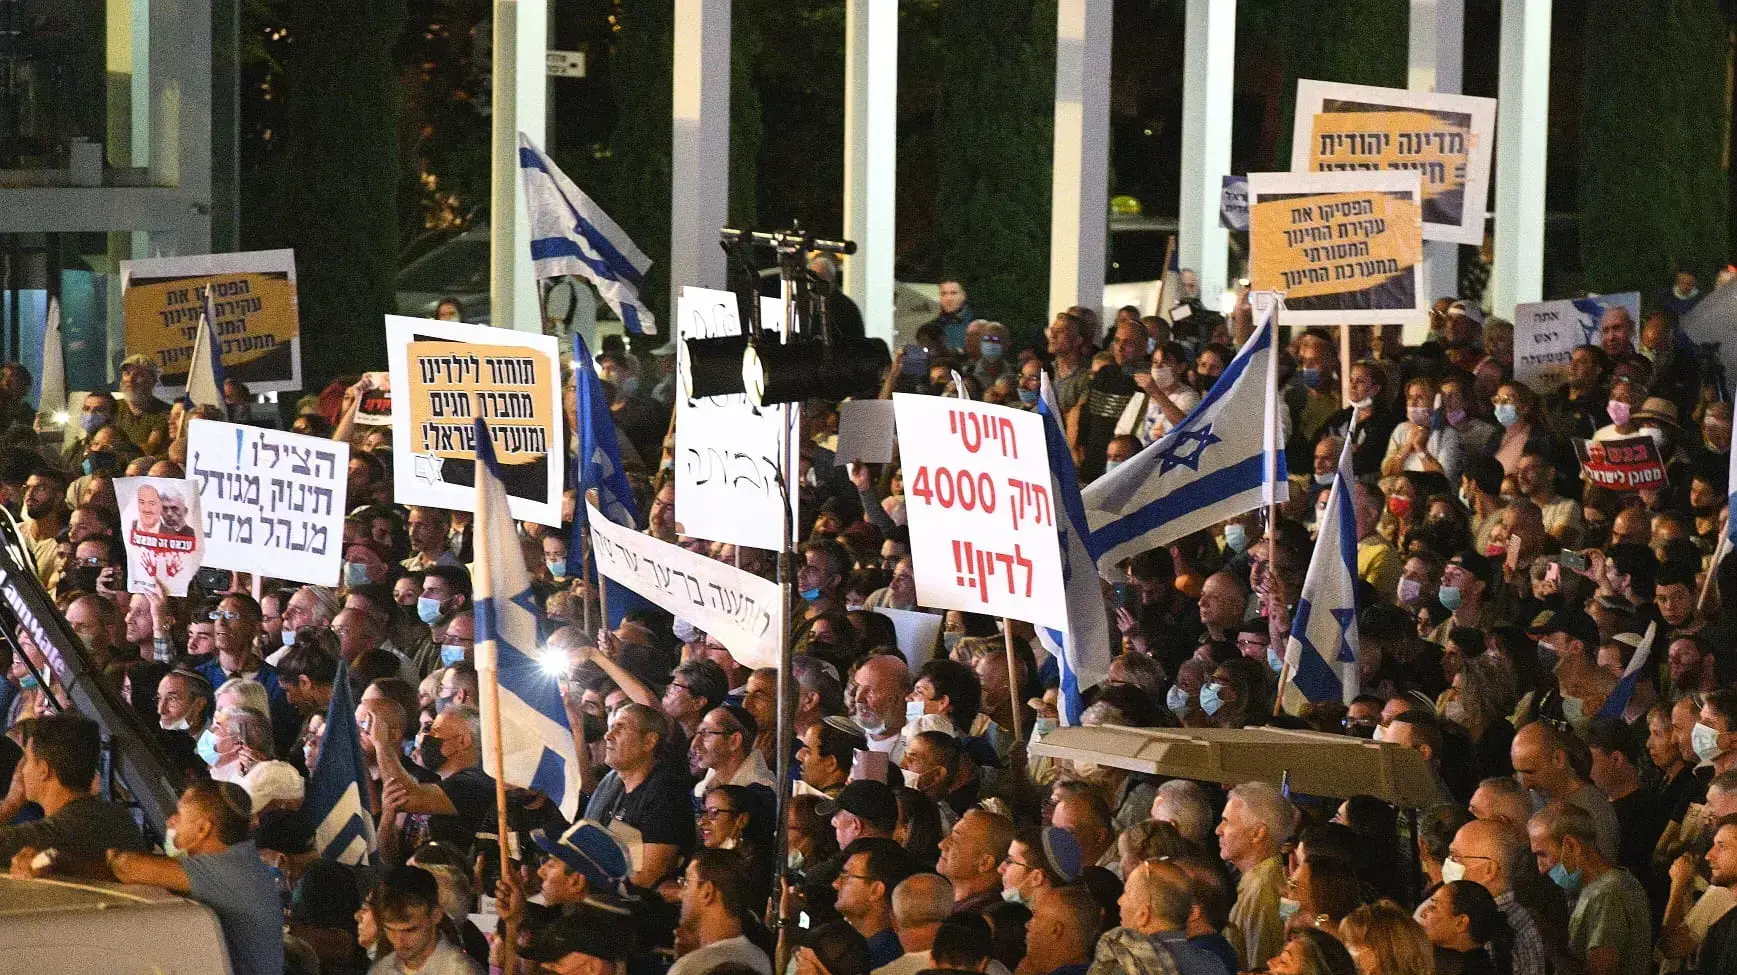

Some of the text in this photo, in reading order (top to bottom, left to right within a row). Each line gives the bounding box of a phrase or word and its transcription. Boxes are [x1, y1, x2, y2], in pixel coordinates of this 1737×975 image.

[1320, 131, 1465, 156] מדינה יהודית
[1291, 199, 1373, 224] הפסיקו את
[1283, 218, 1385, 248] עקירת החינוך
[1303, 241, 1369, 263] המסורתי
[1280, 258, 1398, 290] ממערכת החינוך
[157, 333, 276, 367] ממערכ חינוך
[418, 353, 536, 385] תוחזר לילדינו
[429, 391, 471, 418] חגים
[422, 421, 547, 454] ומועדי שראל!
[949, 410, 1018, 460] חייטי
[252, 431, 336, 480] הצילו
[193, 450, 333, 516] תינוק מגודל
[912, 465, 1052, 531] תיק 4000
[203, 504, 328, 556] מנהל מדינ
[951, 539, 1033, 604] לדין!!
